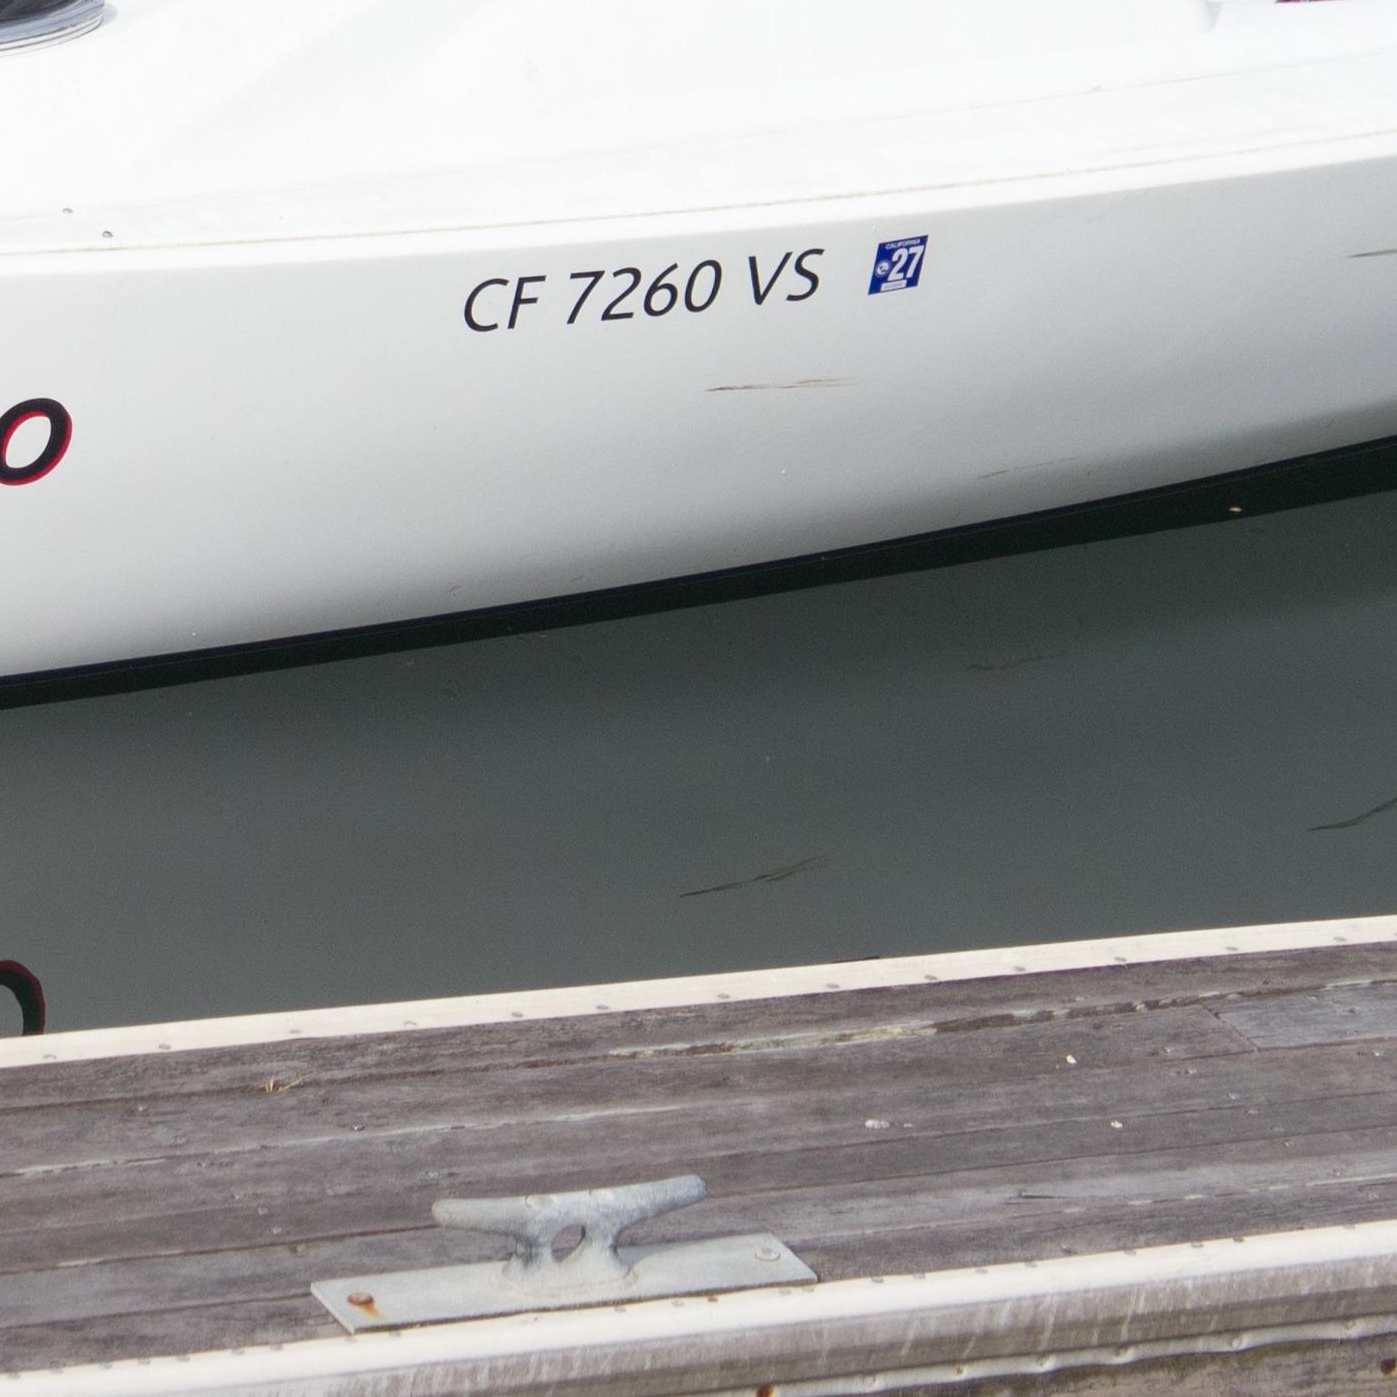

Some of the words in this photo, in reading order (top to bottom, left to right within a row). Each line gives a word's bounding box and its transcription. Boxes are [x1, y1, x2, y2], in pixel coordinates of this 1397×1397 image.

[463, 274, 547, 333] CF
[566, 258, 724, 325] 7260
[748, 247, 825, 306] VS
[887, 244, 925, 282] 27
